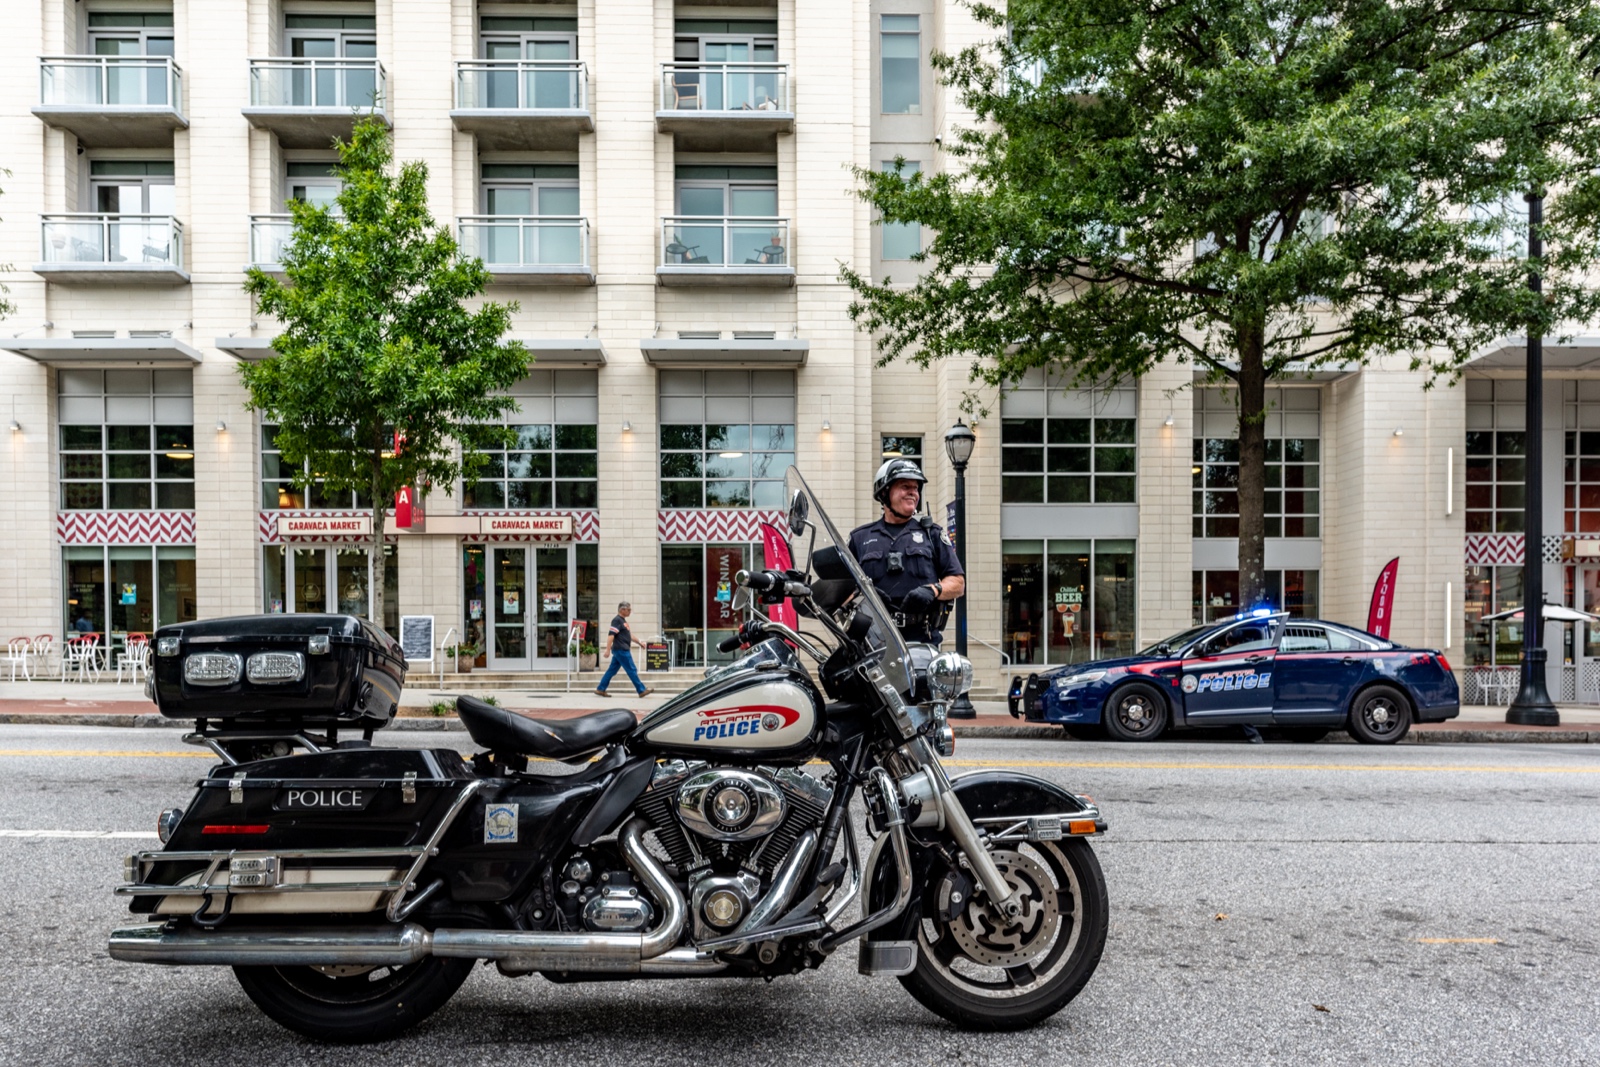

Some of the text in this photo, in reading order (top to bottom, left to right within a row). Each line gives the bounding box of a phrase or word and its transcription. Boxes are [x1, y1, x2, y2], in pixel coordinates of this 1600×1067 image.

[288, 521, 361, 531] CARAVACA MARKET
[491, 520, 564, 530] CARAVACA MARKET
[1055, 593, 1082, 603] BEER
[1376, 571, 1390, 619] FOOD
[1201, 669, 1255, 680] ATLANTA
[1196, 672, 1272, 693] POLICE
[700, 713, 761, 726] ATLANTA
[693, 719, 760, 741] POLICE
[288, 790, 362, 806] POLICE
